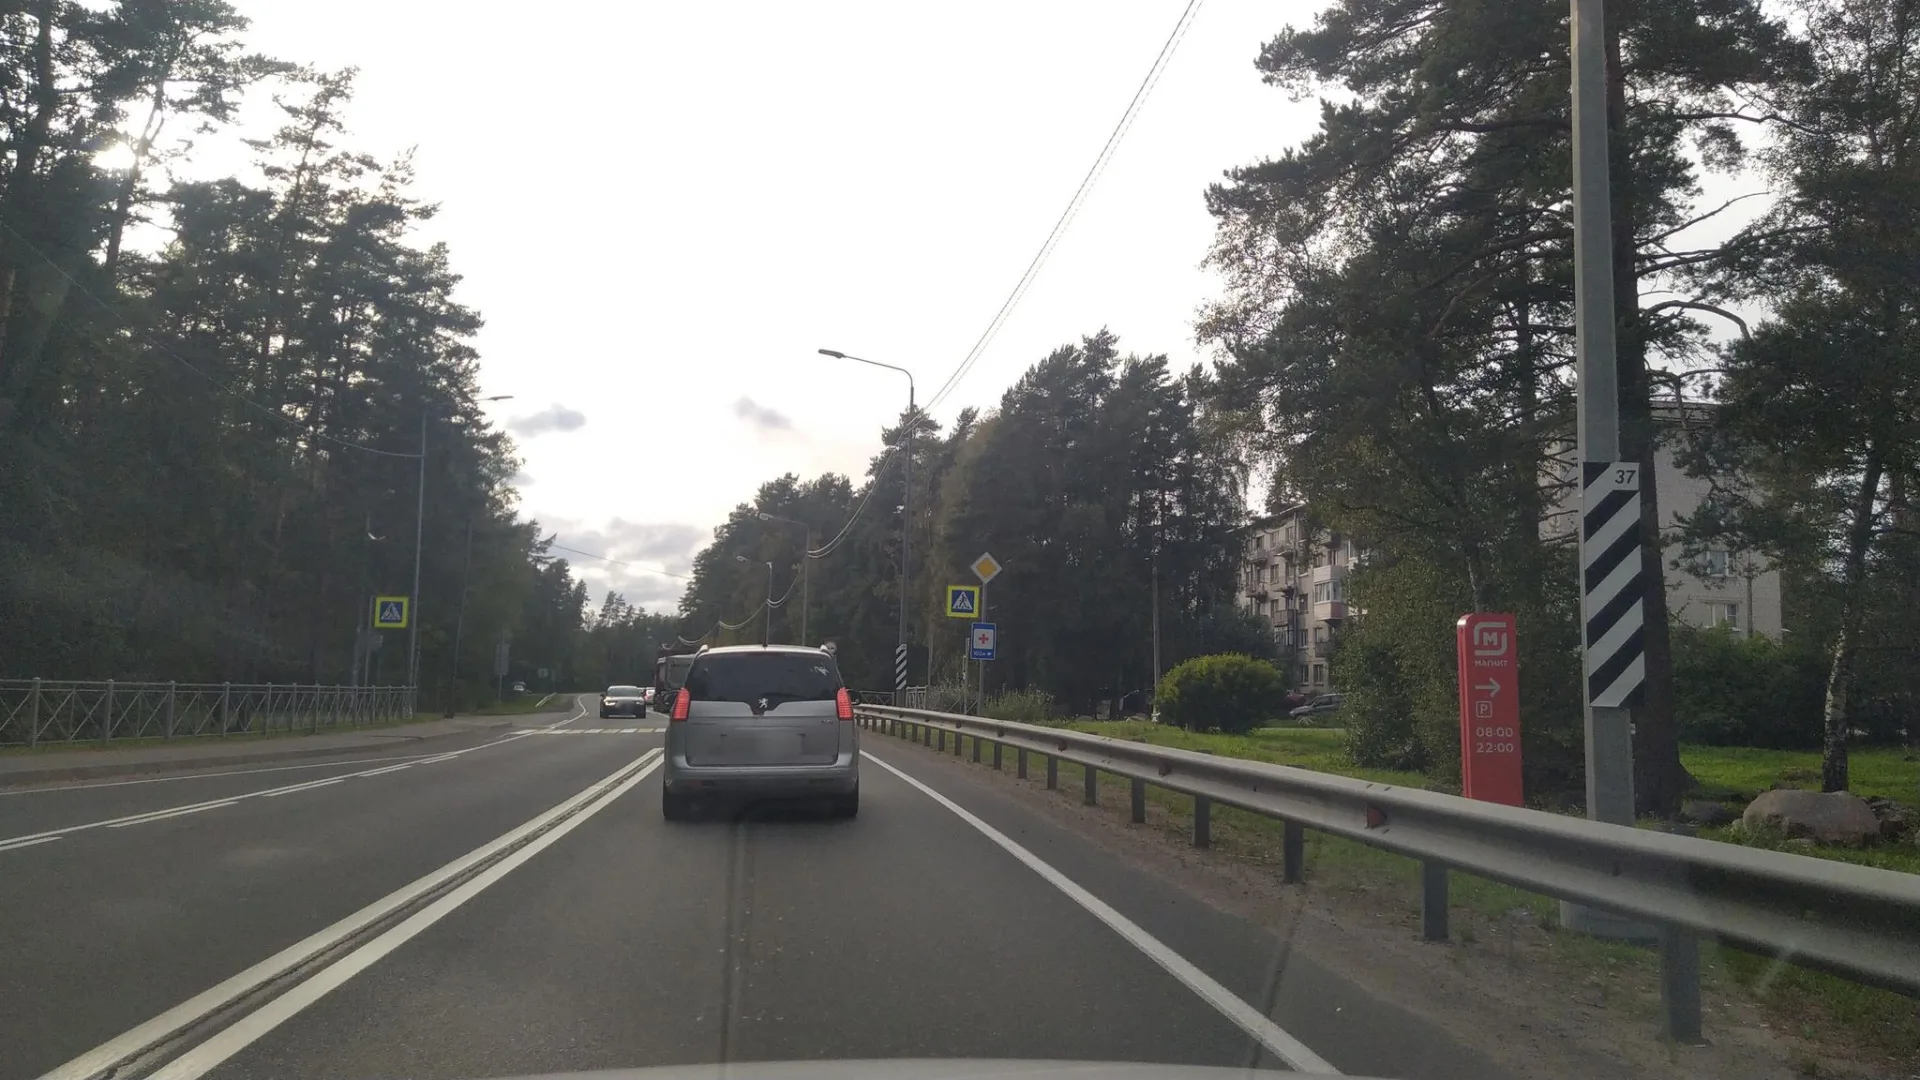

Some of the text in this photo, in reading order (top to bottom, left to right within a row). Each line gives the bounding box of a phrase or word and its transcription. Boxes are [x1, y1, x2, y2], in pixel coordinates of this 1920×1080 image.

[1615, 469, 1636, 484] 37
[1476, 727, 1514, 737] 08:00
[1476, 743, 1514, 753] 22:00
